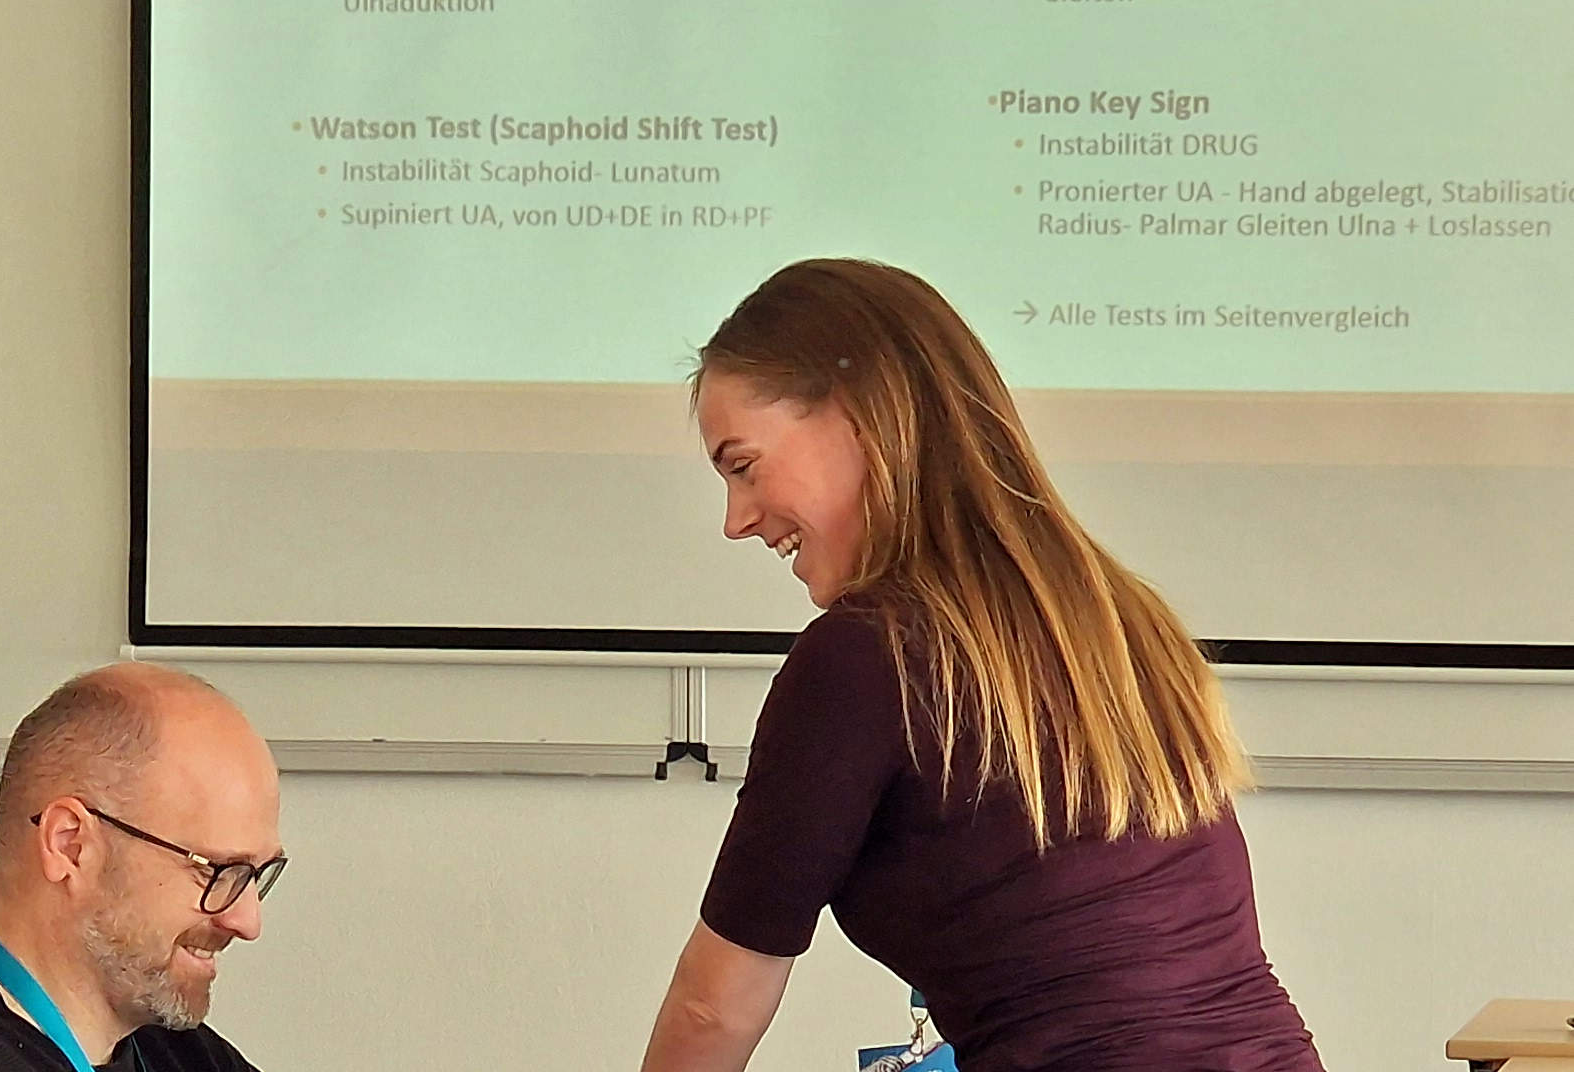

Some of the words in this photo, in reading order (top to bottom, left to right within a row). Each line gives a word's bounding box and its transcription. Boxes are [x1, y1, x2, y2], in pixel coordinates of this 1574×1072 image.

[1000, 89, 1080, 114] Piano
[1090, 91, 1141, 120] Key
[1151, 89, 1210, 120] Sign
[311, 116, 416, 141] Watson
[426, 116, 481, 140] Test
[490, 114, 628, 147] (Scaphoid
[637, 116, 703, 141] Shift
[711, 115, 779, 148] Test)
[1039, 132, 1173, 157] Instabilität
[1182, 133, 1258, 157] DRUG
[342, 158, 471, 182] Instabilität
[480, 159, 602, 188] Scaphoid-
[611, 161, 721, 184] Lunatum
[1039, 179, 1169, 203] Pronierter
[1177, 180, 1214, 203] UA
[1239, 179, 1306, 204] Hand
[1314, 179, 1432, 209] abgelegt,
[341, 202, 453, 230] Supiniert
[461, 203, 504, 230] UA,
[512, 209, 557, 227] von
[566, 205, 653, 227] UD+DE
[661, 205, 683, 227] in
[692, 205, 772, 228] RD+PF
[1038, 211, 1131, 236] Radius-
[1140, 212, 1229, 236] Palmar
[1236, 212, 1329, 237] Gleiten
[1338, 212, 1396, 237] Ulna
[1428, 213, 1551, 238] Loslassen
[1048, 302, 1097, 326] Alle
[1105, 303, 1167, 327] Tests
[1175, 303, 1206, 327] im
[1214, 304, 1410, 333] Seitenvergleich
